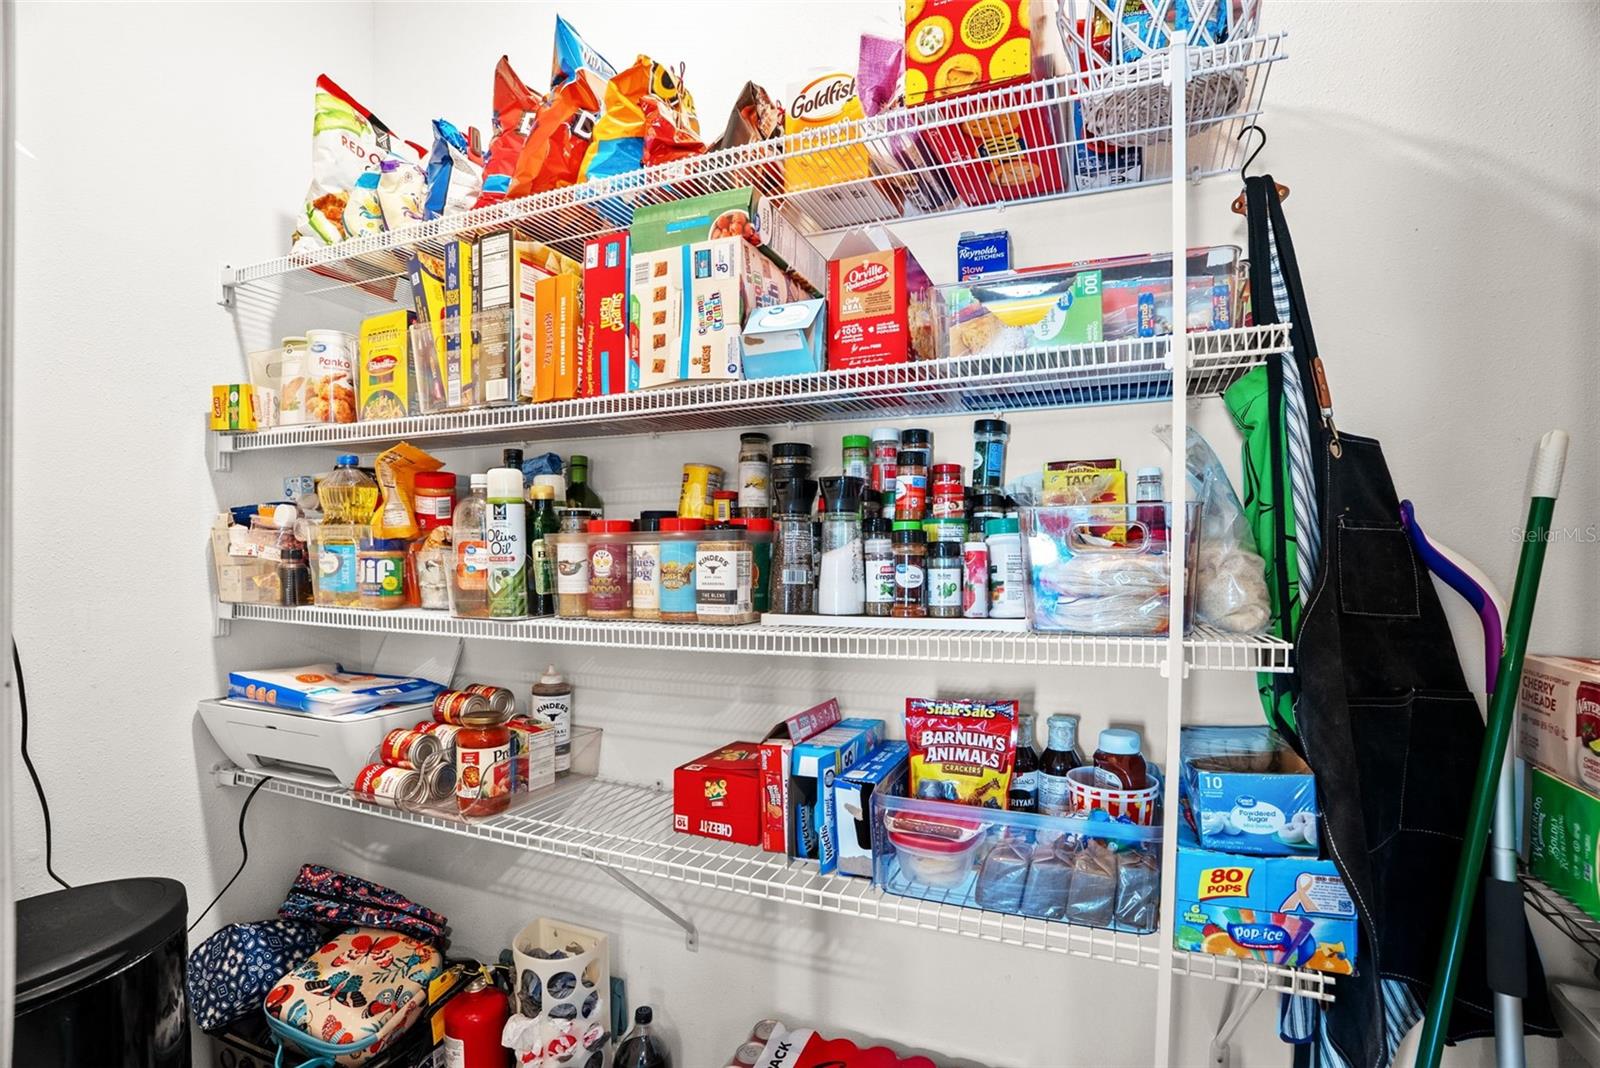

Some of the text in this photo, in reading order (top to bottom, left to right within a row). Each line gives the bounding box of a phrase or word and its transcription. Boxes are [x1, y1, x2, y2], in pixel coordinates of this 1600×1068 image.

[341, 135, 365, 158] RED
[959, 245, 997, 259] Reynolds
[974, 252, 1004, 261] KITCHENS
[849, 264, 883, 282] Orville
[962, 266, 984, 274] Slow
[1084, 274, 1098, 295] 100
[600, 297, 612, 329] Lucky
[610, 292, 624, 331] Charms
[704, 301, 713, 327] Toast
[712, 291, 724, 332] Crunch
[841, 326, 863, 335] 100%
[319, 356, 350, 368] Panko
[1065, 474, 1100, 486] TACO
[488, 528, 517, 543] Olive
[491, 541, 513, 556] Oil
[358, 559, 395, 583] Jif
[1522, 675, 1555, 696] CHERRY
[1521, 688, 1556, 712] LIMEADE
[1577, 697, 1600, 717] WATER
[921, 730, 1006, 752] BARNUM'S
[925, 747, 999, 769] ANIMALS
[944, 764, 982, 774] CRACKERS
[1205, 776, 1223, 789] 10
[1011, 799, 1035, 807] RIYAKI
[1530, 796, 1544, 860] WATERLOO
[1548, 815, 1560, 860] BOLDLY
[1211, 869, 1243, 883] 80
[1207, 884, 1242, 894] POPS
[1191, 904, 1200, 913] 6
[768, 1041, 792, 1068] ACK
